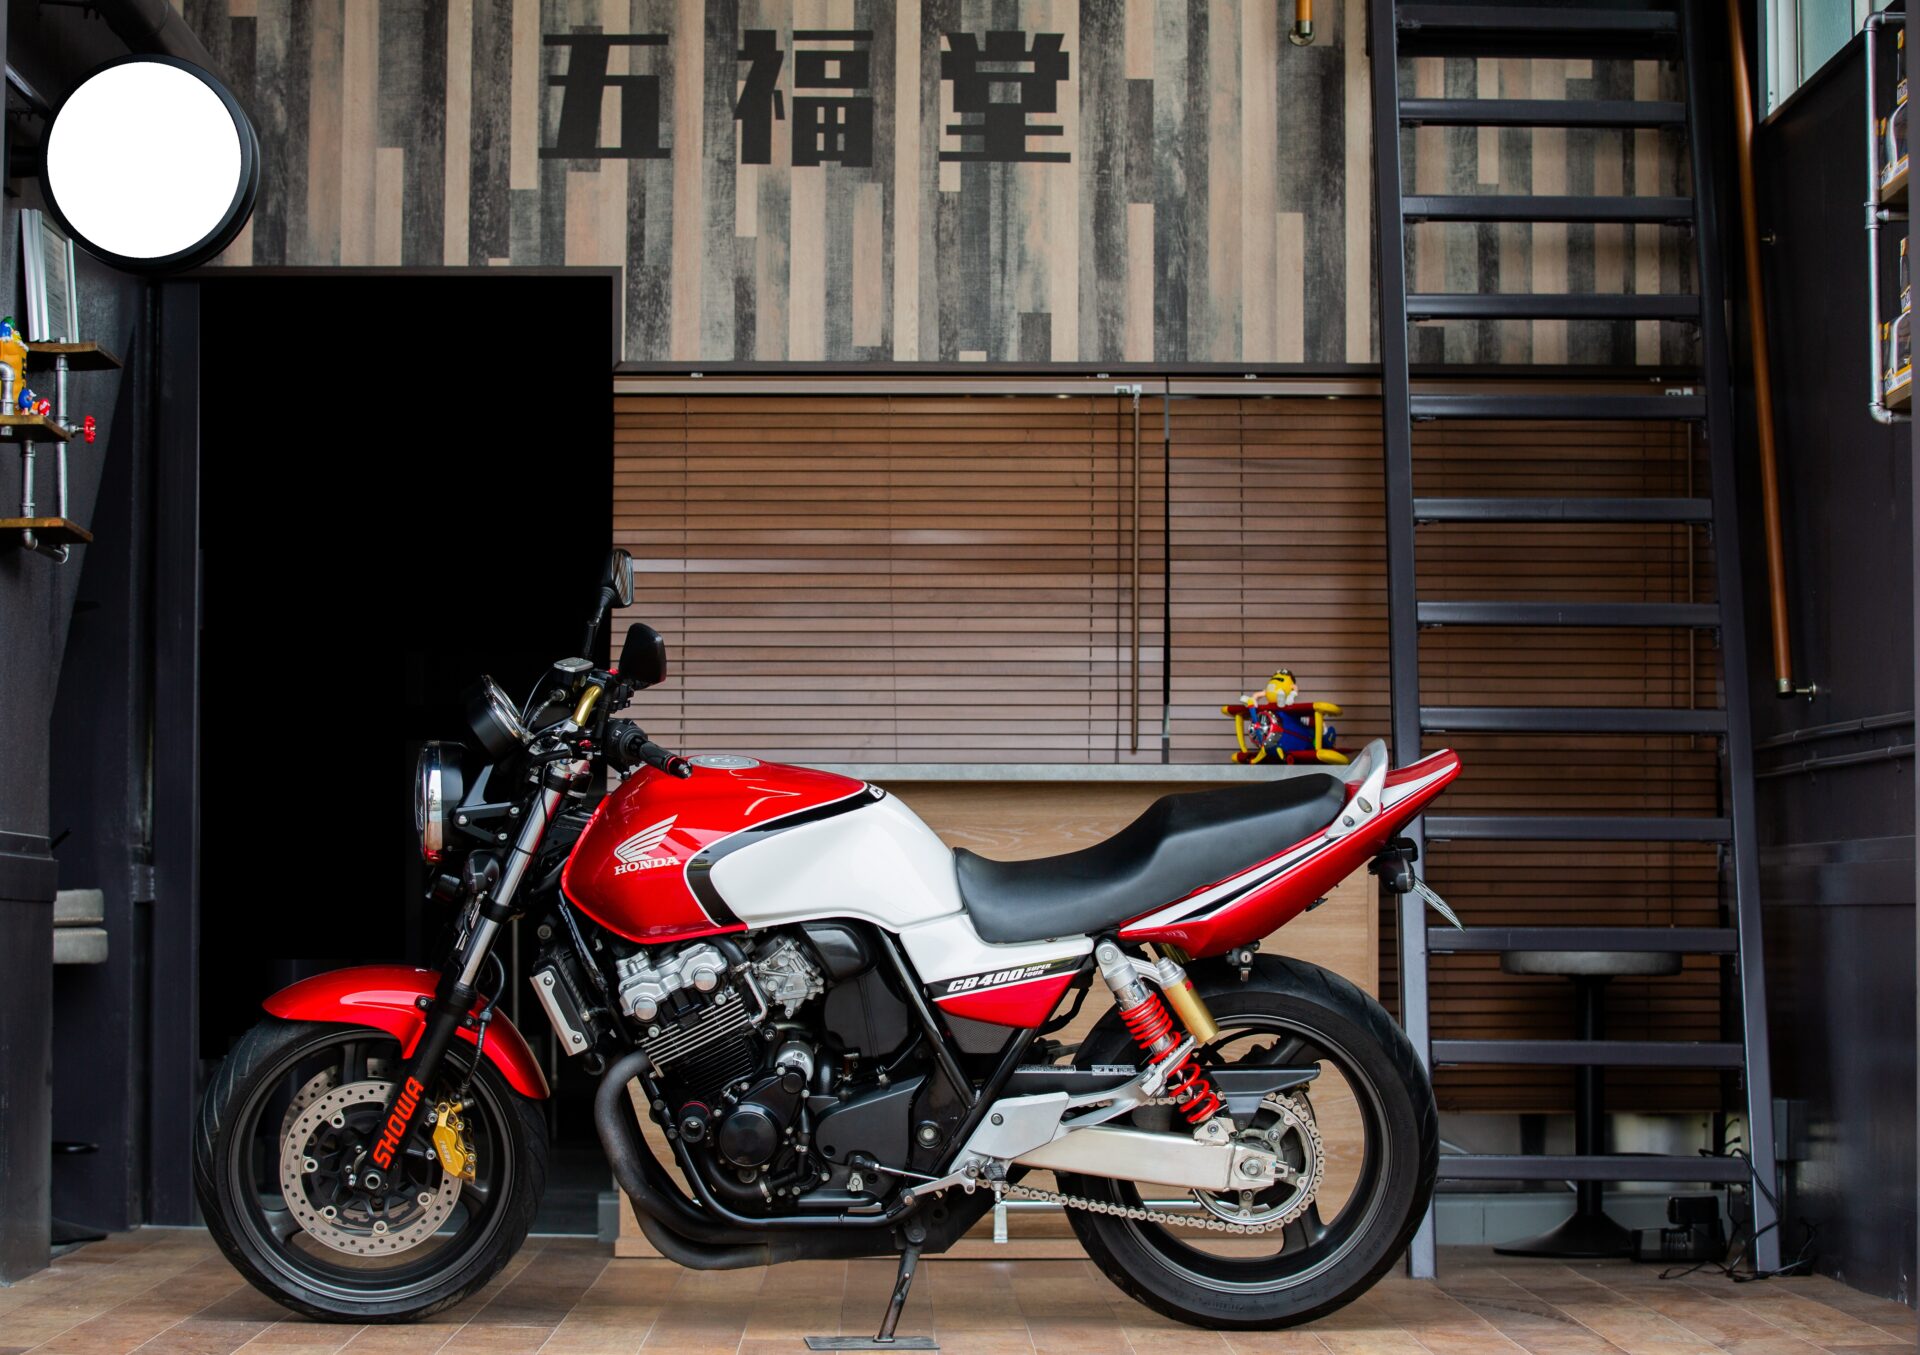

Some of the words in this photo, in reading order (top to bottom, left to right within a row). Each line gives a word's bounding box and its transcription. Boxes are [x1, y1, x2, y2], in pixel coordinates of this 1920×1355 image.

[539, 30, 1071, 167] 五福堂
[614, 856, 681, 875] HONDA
[1026, 963, 1052, 972] SUPER
[947, 968, 1025, 992] CB400
[373, 1076, 424, 1169] SHOWA
